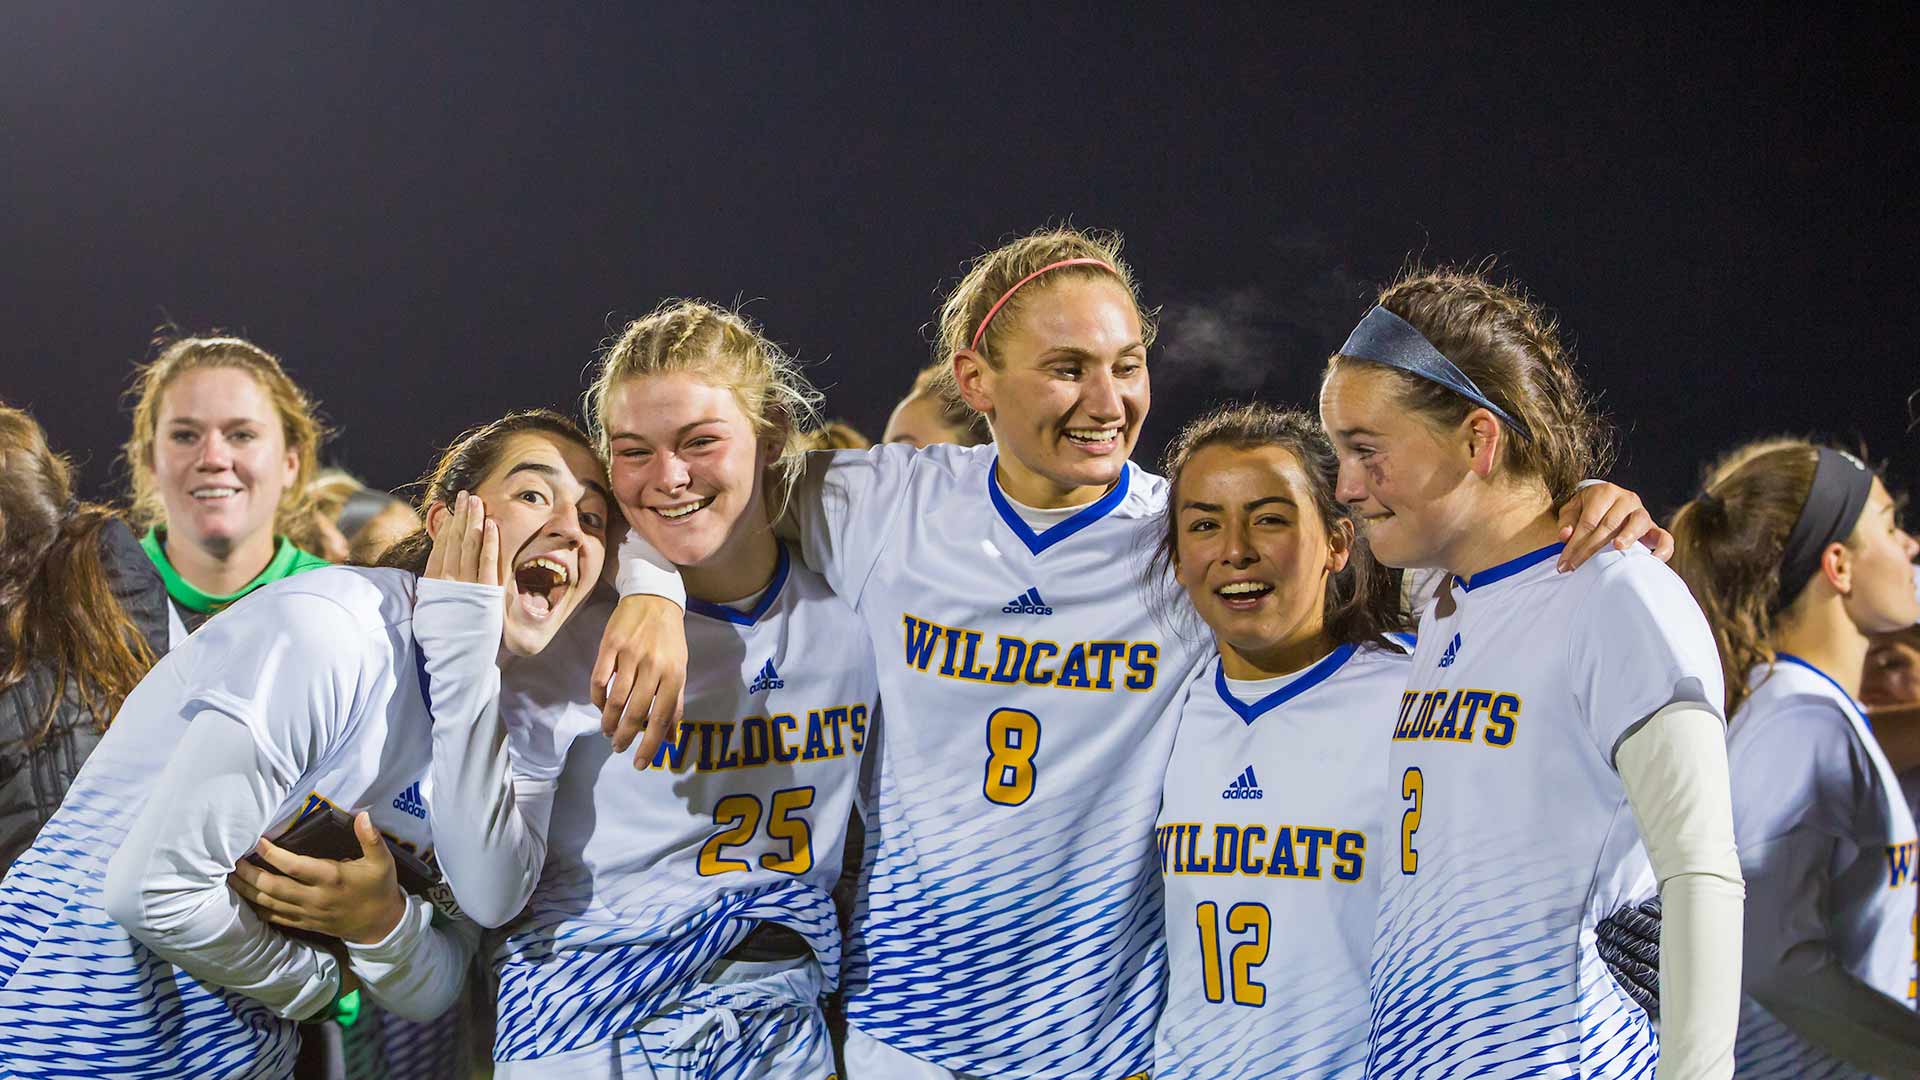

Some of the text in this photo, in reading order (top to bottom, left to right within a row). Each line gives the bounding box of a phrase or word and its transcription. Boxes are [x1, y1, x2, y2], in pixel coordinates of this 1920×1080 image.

[902, 612, 1160, 692] WILDCATS
[1002, 603, 1053, 616] adidas
[983, 707, 1042, 807] 8
[1222, 786, 1263, 800] adidas
[392, 797, 427, 820] adidas
[696, 786, 816, 877] 25
[1401, 766, 1424, 876] 2
[1196, 900, 1272, 1009] 12
